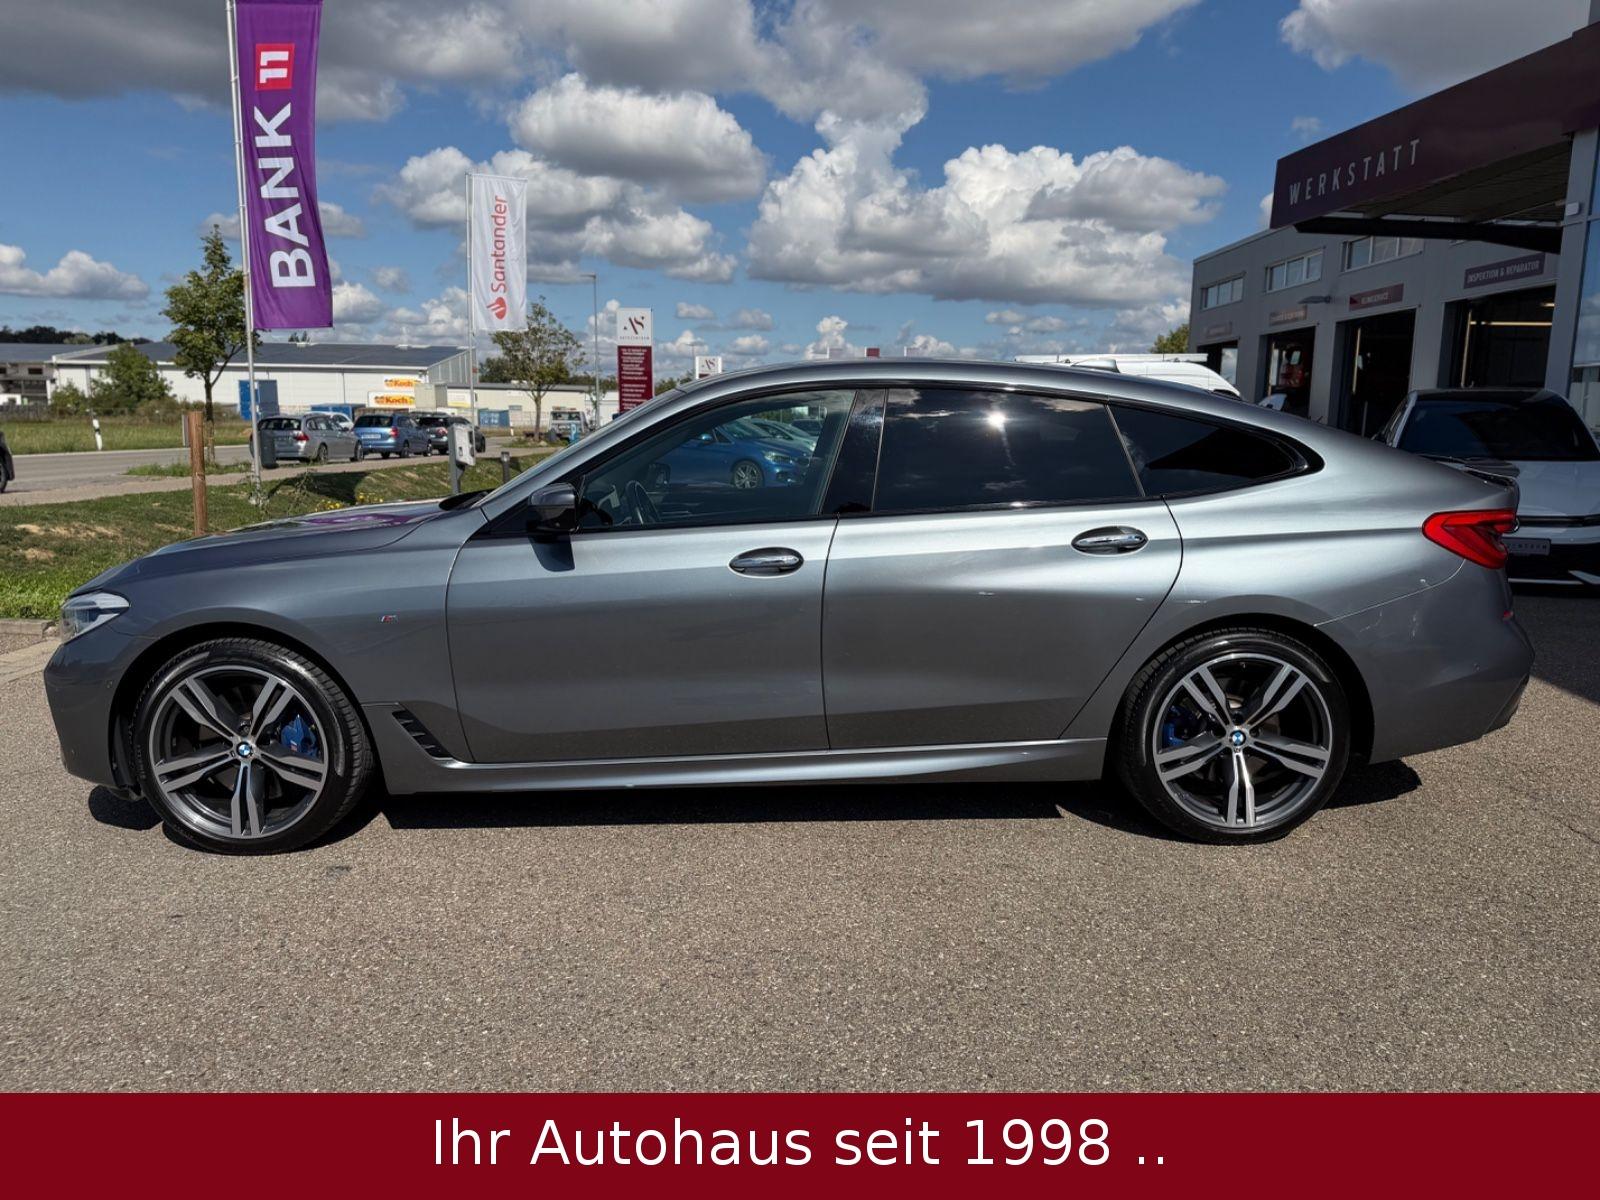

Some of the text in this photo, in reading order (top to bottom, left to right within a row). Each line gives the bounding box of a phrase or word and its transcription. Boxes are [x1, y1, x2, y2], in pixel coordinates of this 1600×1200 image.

[253, 50, 316, 288] BANK 11
[1287, 136, 1420, 206] WERKSTATT
[491, 194, 507, 294] Santander
